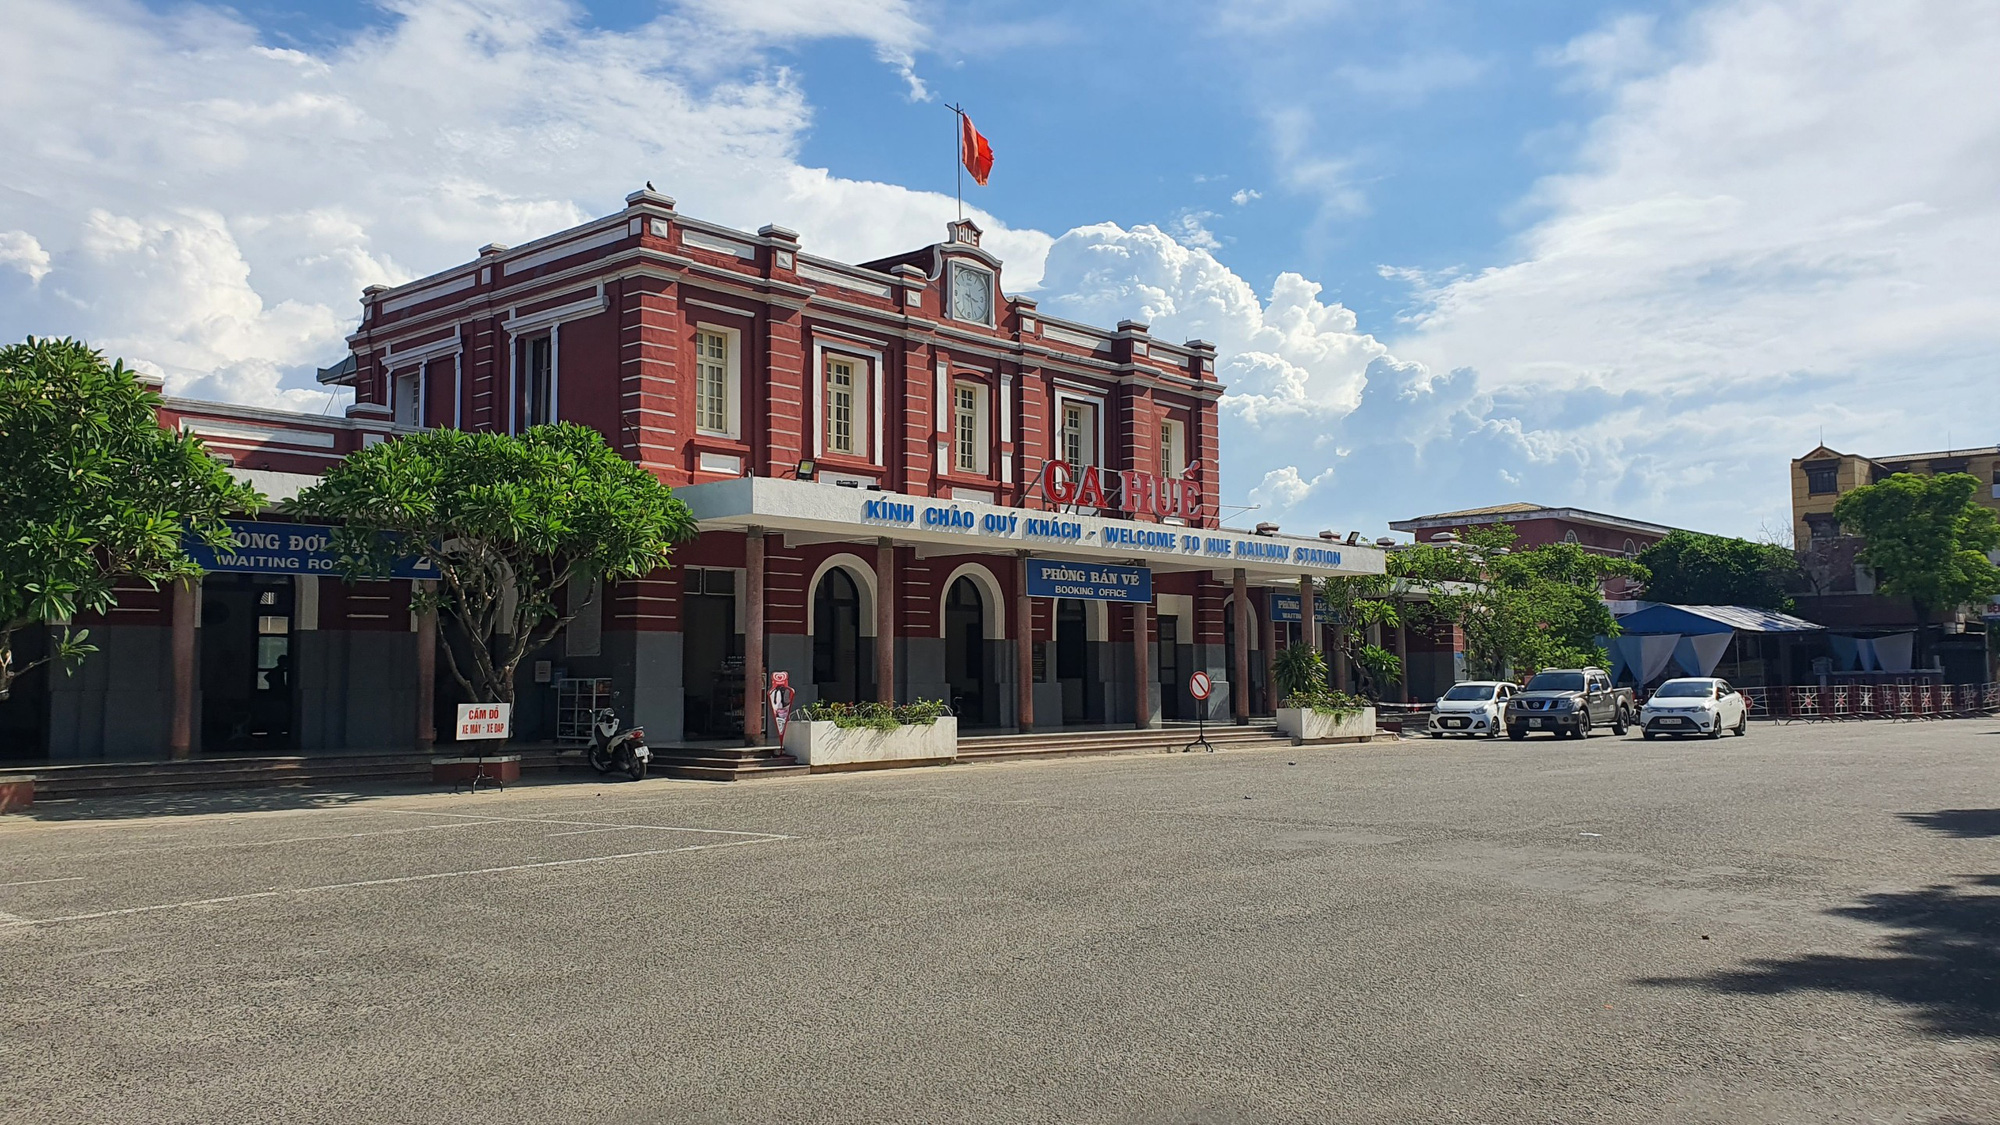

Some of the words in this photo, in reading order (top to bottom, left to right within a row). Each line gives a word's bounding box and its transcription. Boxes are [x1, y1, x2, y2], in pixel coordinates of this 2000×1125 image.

[959, 226, 978, 245] HUE
[1041, 460, 1108, 508] GA
[1119, 460, 1202, 520] HUẾ
[867, 496, 914, 522] KÍNH
[985, 511, 1018, 533] QUÝ
[1028, 516, 1081, 539] KHÁCH
[1105, 527, 1176, 549] WELCOME
[1184, 534, 1200, 551] TO
[1207, 537, 1231, 554] HUE
[1238, 541, 1290, 559] RAILWAY
[1297, 546, 1341, 565] STATION
[288, 533, 327, 556] ĐỢI
[220, 554, 299, 568] WAITING
[1041, 565, 1086, 582] PHÒNG
[1090, 568, 1118, 584] BÁN
[1121, 570, 1140, 586] VÉ
[1055, 585, 1094, 596] BOOKING
[1098, 588, 1128, 598] OFFICE
[468, 706, 487, 720] CẤM
[462, 724, 469, 734] XE
[487, 723, 493, 733] XE
